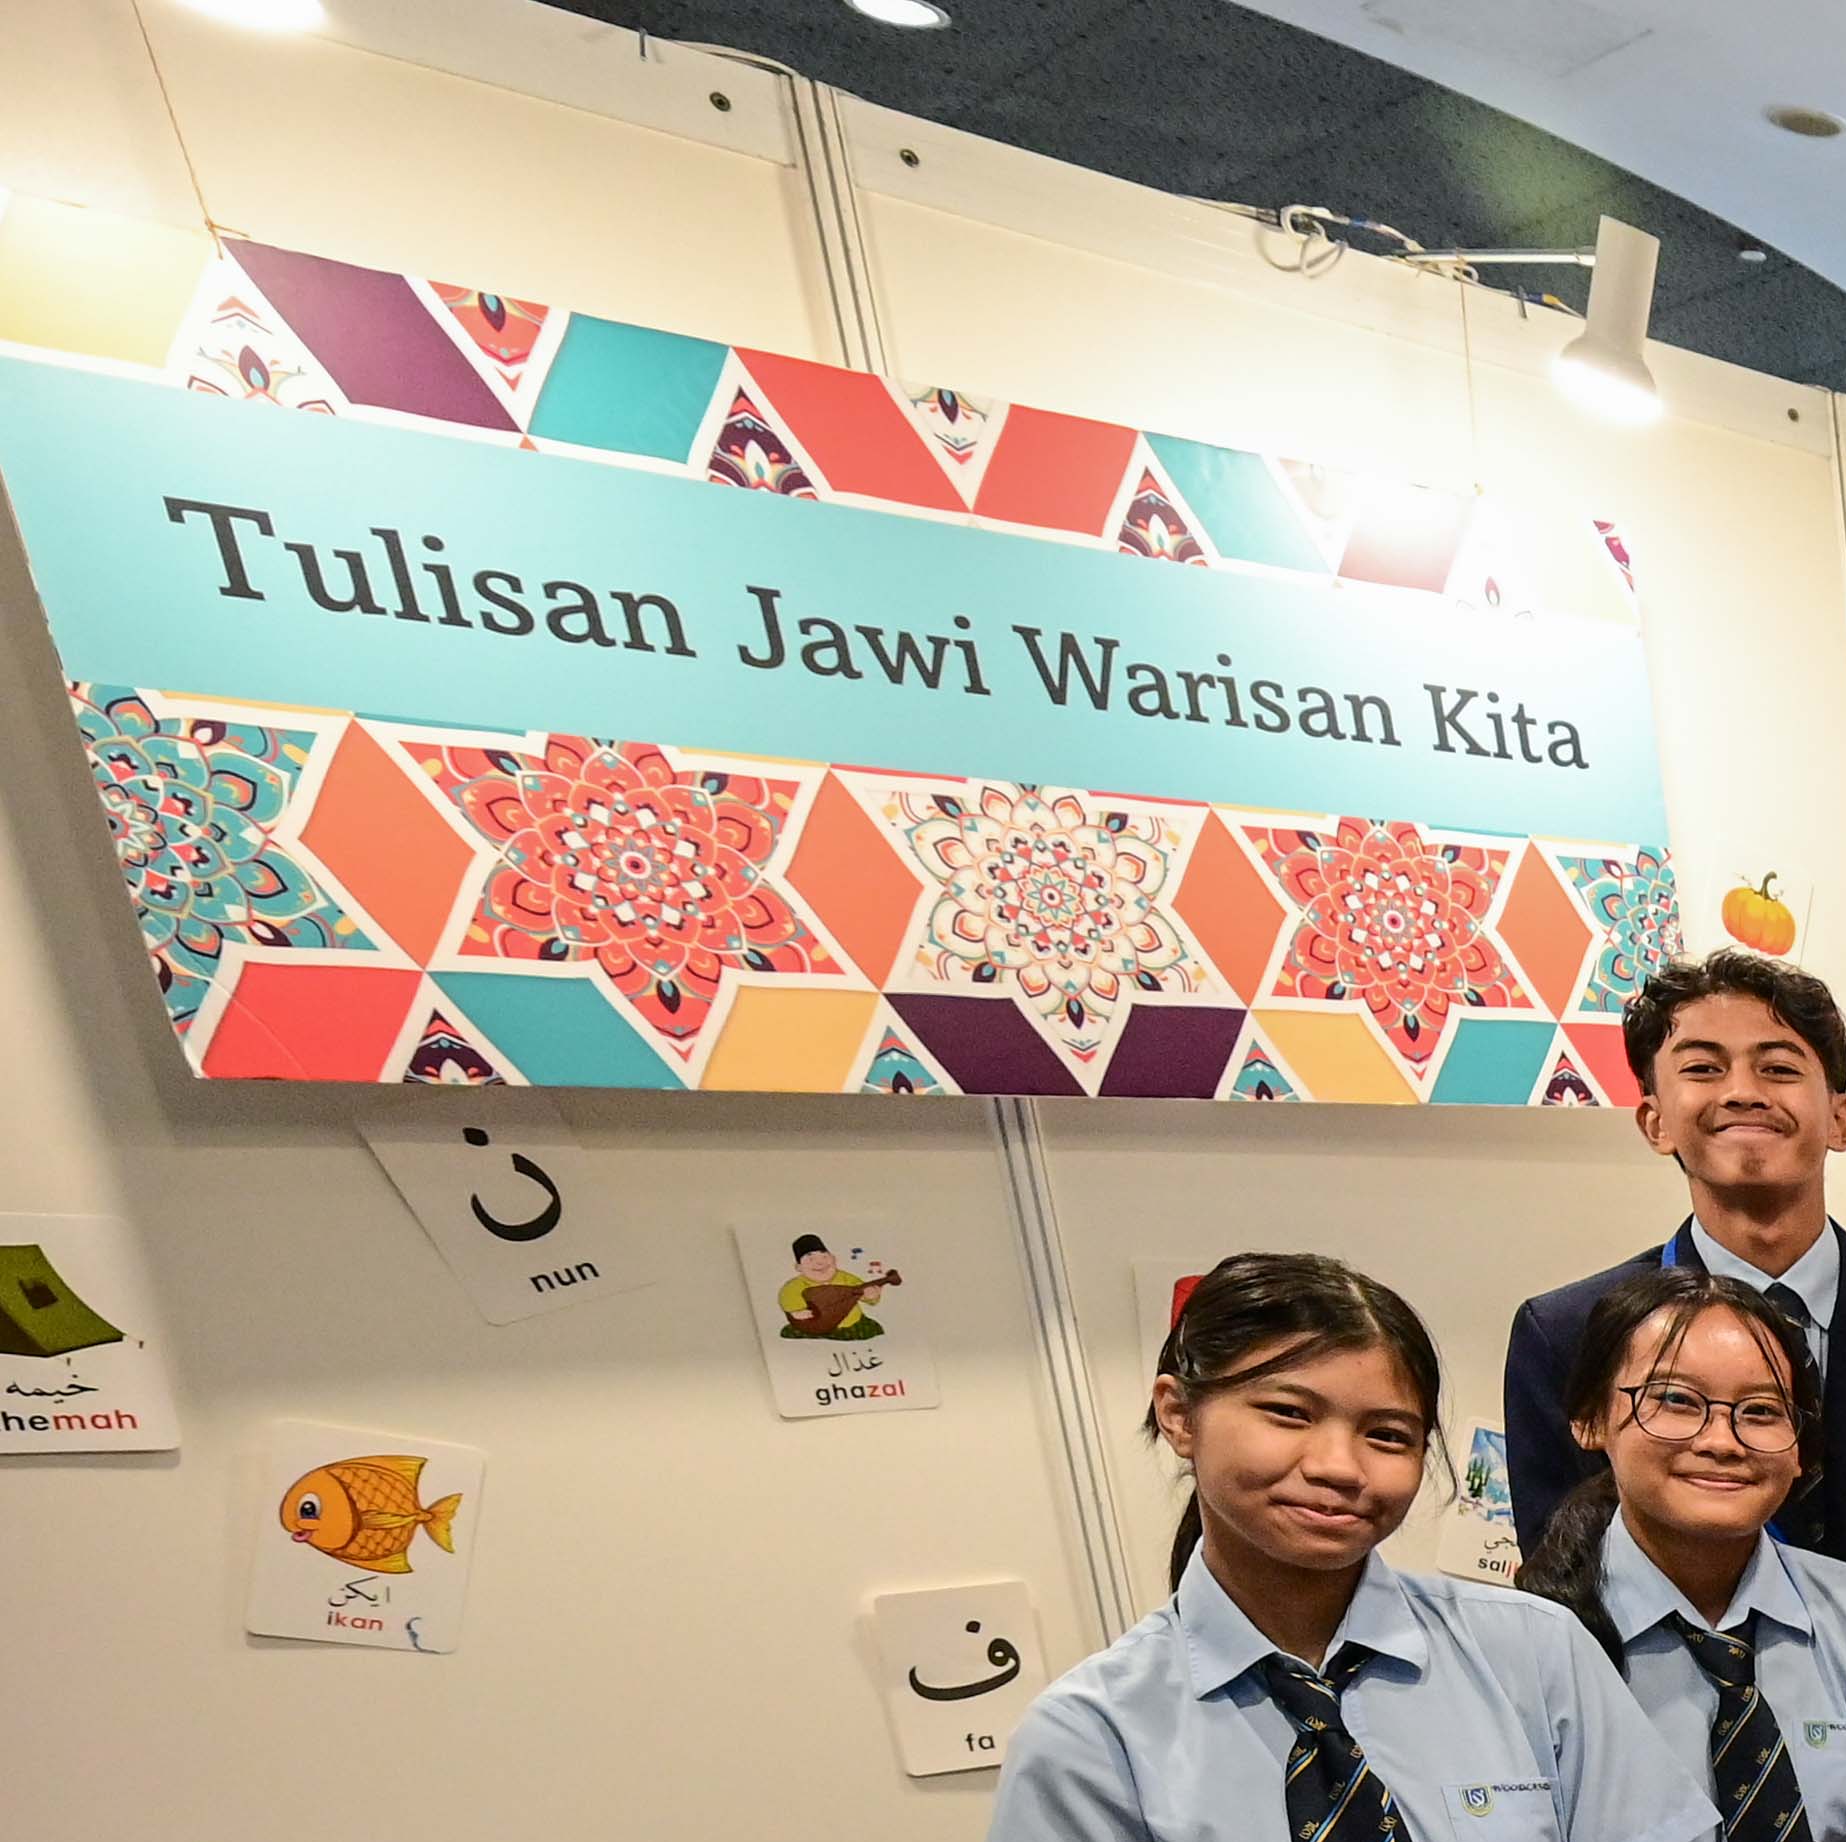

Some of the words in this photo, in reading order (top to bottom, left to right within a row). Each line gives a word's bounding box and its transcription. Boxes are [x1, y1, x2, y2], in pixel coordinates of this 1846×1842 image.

[164, 494, 697, 658] Tulisan
[738, 584, 992, 697] Jawi
[1014, 624, 1404, 747] Warisan
[1422, 682, 1591, 771] Kita
[463, 1127, 562, 1242] ن
[530, 1260, 600, 1294] nun
[815, 1379, 905, 1406] ghazal
[0, 1409, 137, 1431] hemah
[326, 1610, 383, 1632] ikan
[908, 1620, 1021, 1701] ف
[965, 1731, 995, 1752] fa
